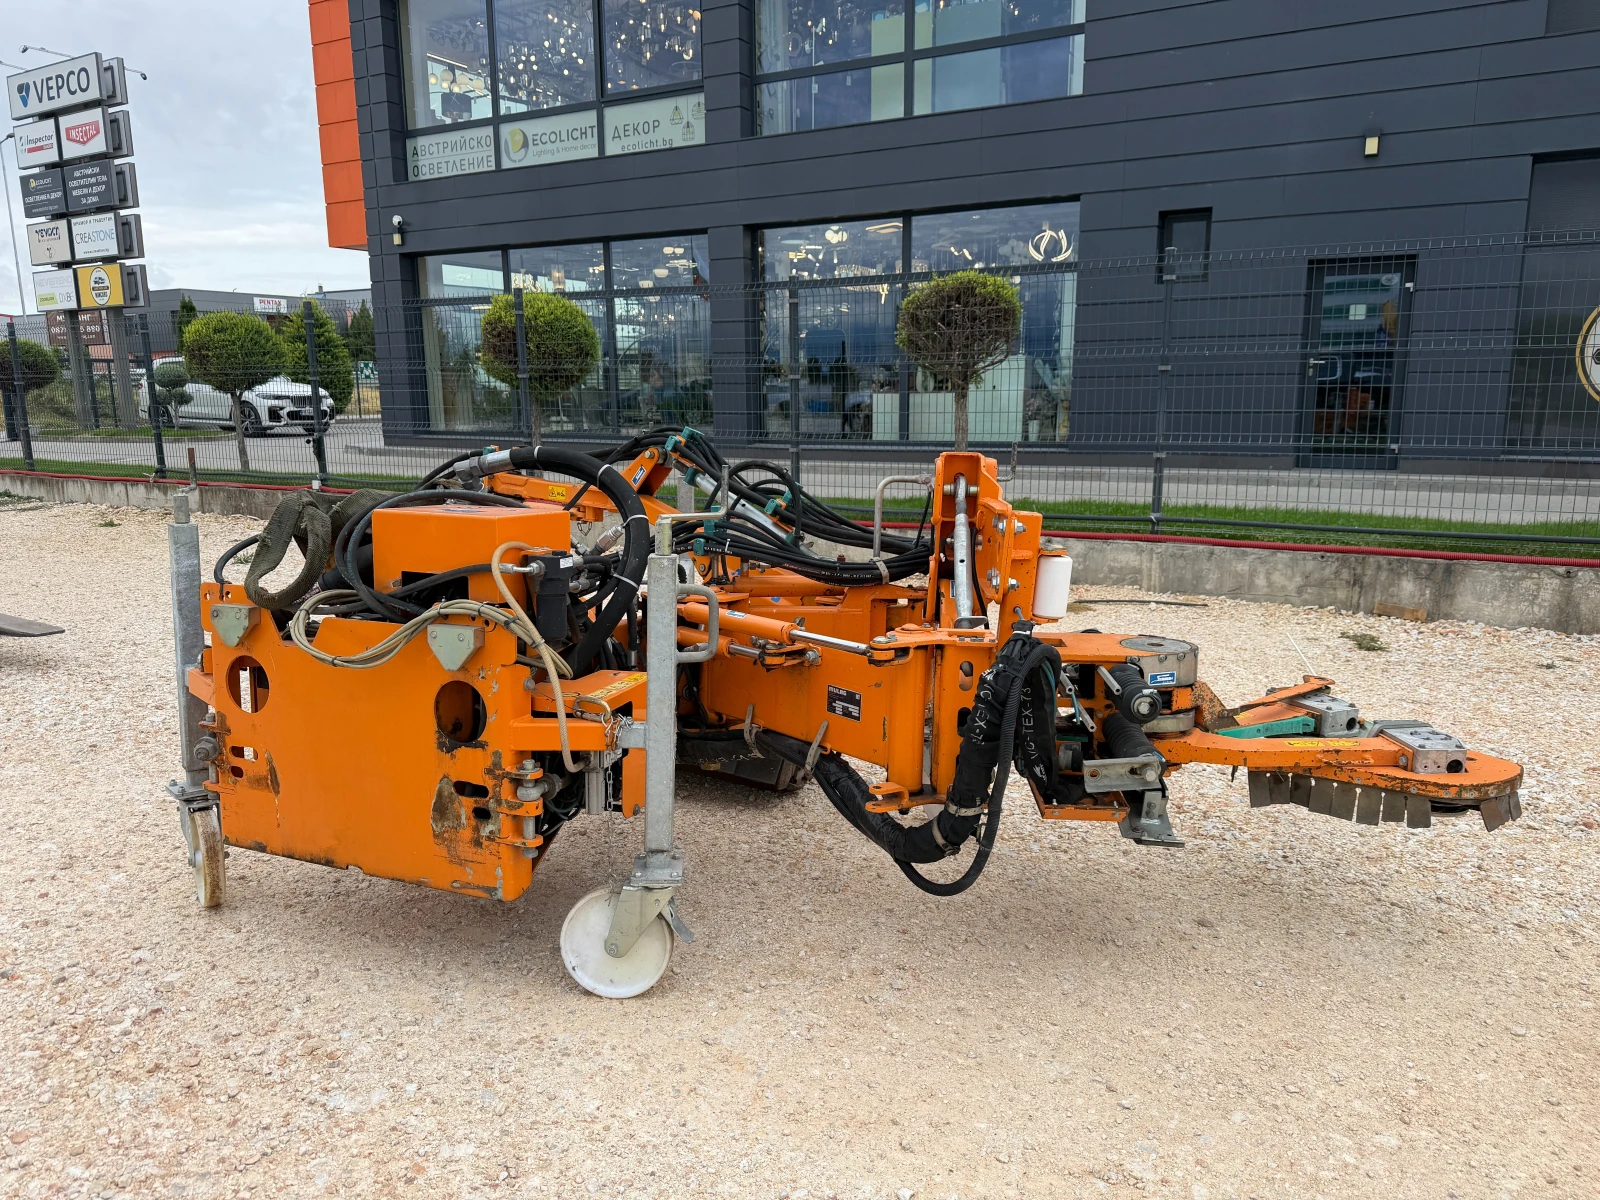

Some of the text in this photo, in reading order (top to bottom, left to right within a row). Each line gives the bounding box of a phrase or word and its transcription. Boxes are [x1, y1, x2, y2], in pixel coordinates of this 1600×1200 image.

[33, 67, 90, 103] VEPCO
[69, 124, 97, 141] INSECTAL
[532, 125, 596, 147] ECOLICHT
[612, 119, 660, 141] ДЕКОР
[26, 134, 54, 146] Inspector
[412, 134, 492, 158] АВСТРИЙСКО
[621, 137, 673, 152] ecolicht.bg
[532, 147, 555, 157] Lighting
[561, 145, 579, 153] Home
[580, 143, 596, 151] decor
[412, 155, 493, 177] ОСВЕТЛЕНИЕ
[75, 228, 115, 245] CREASTONE
[259, 298, 282, 306] PENTAX
